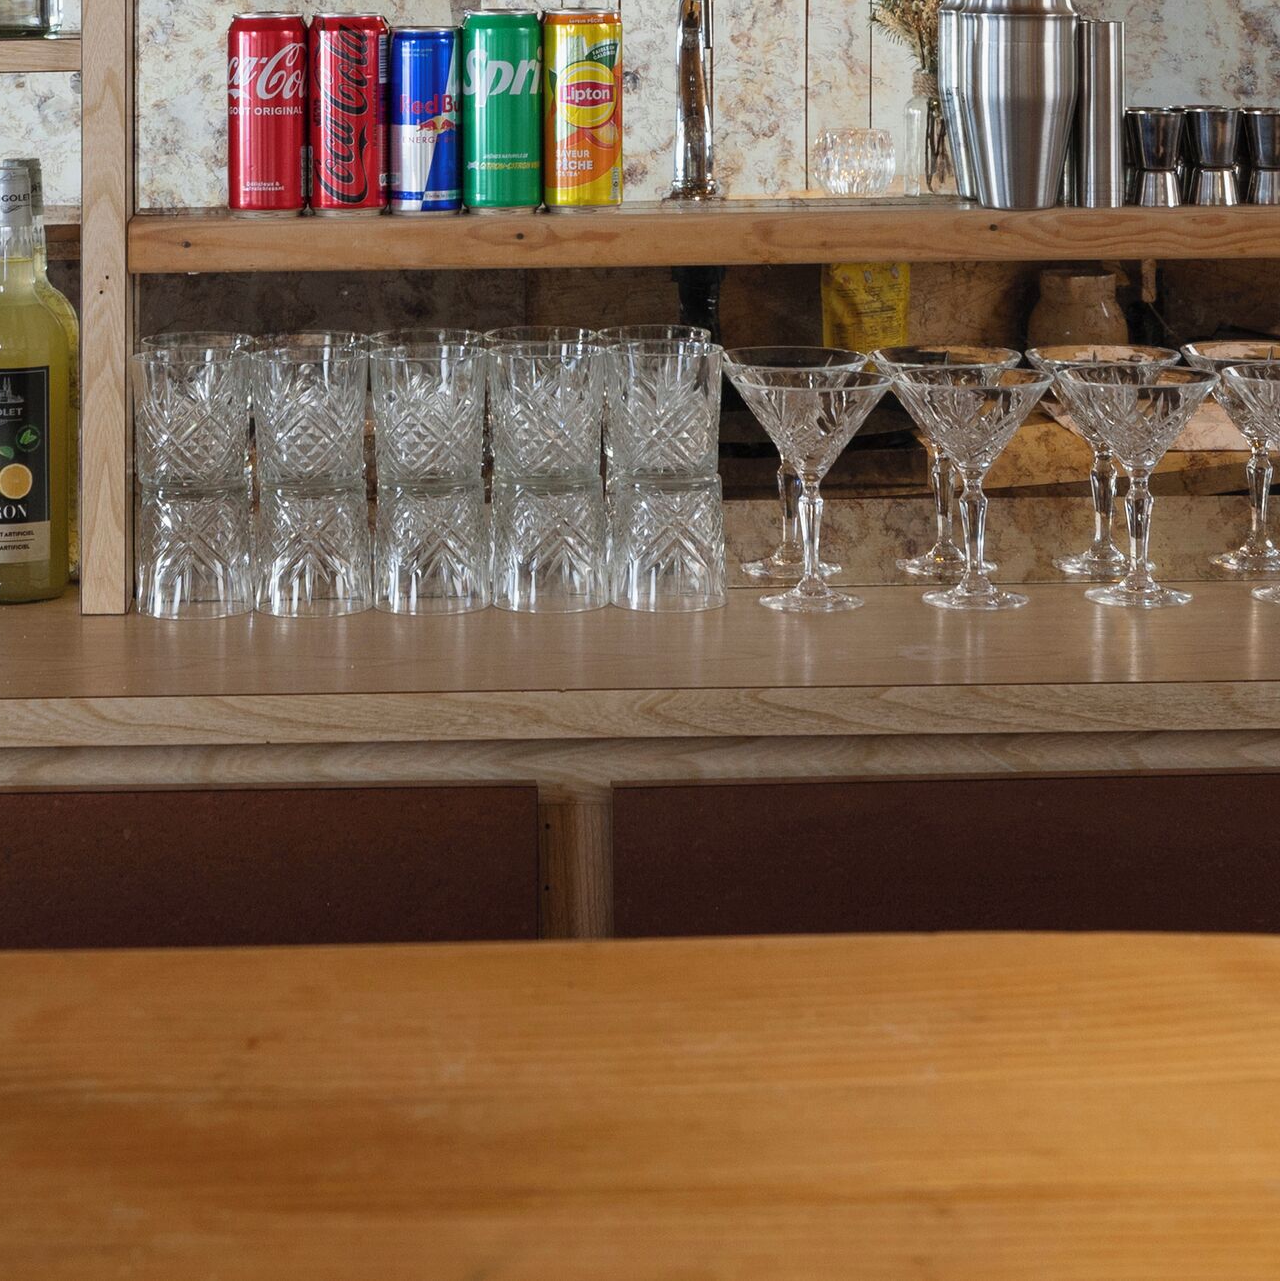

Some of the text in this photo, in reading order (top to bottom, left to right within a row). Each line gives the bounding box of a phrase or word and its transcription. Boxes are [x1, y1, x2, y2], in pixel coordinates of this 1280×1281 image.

[463, 47, 543, 108] Spri
[561, 86, 610, 106] Lipton
[399, 93, 439, 115] Red
[253, 105, 303, 116] ORIGINAL
[556, 149, 590, 158] SAVEUR
[4, 529, 35, 537] ARTIFICIEL
[0, 543, 30, 551] ARTIFICIEL
